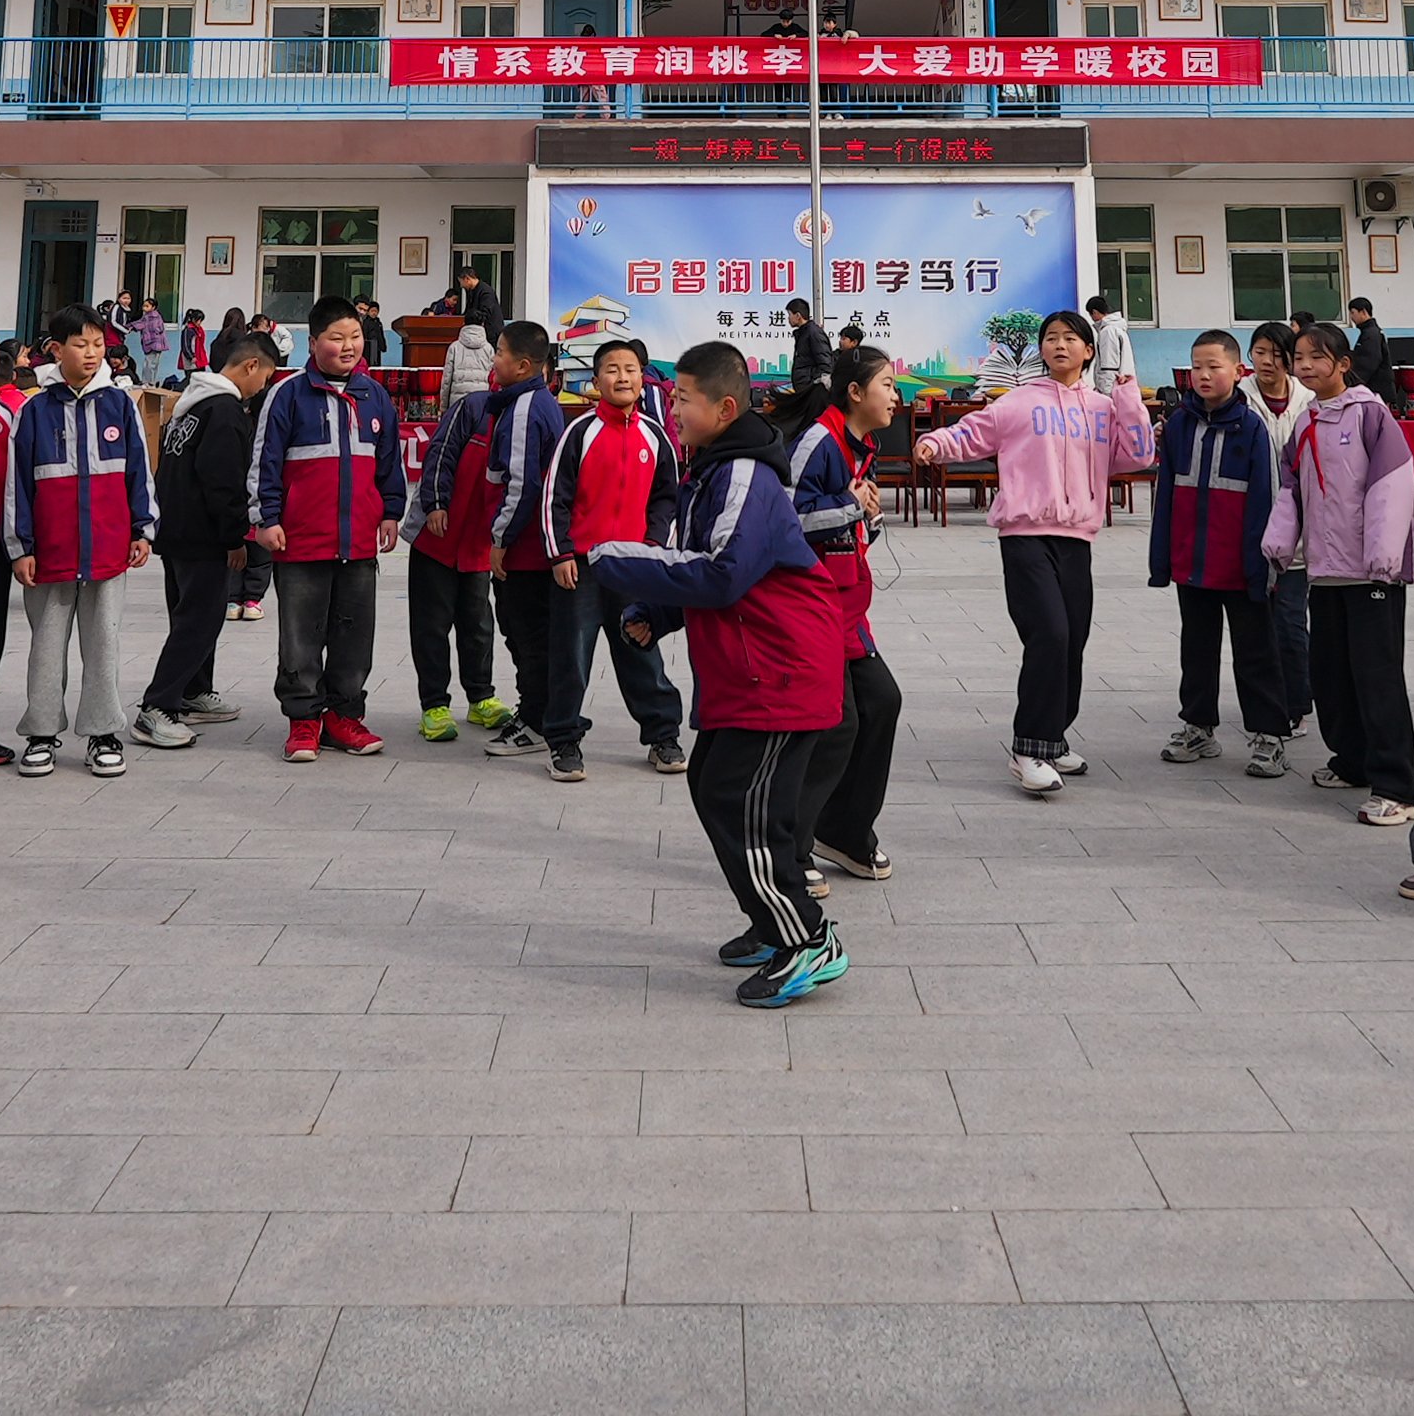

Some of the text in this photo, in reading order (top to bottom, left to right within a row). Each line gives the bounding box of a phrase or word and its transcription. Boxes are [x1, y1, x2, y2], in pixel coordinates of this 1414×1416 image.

[437, 44, 1219, 79] 情系教育润桃李 大爱助学暖校园
[627, 259, 1000, 294] 启智润心 勤学笃行
[716, 310, 891, 327] 每天进一点点
